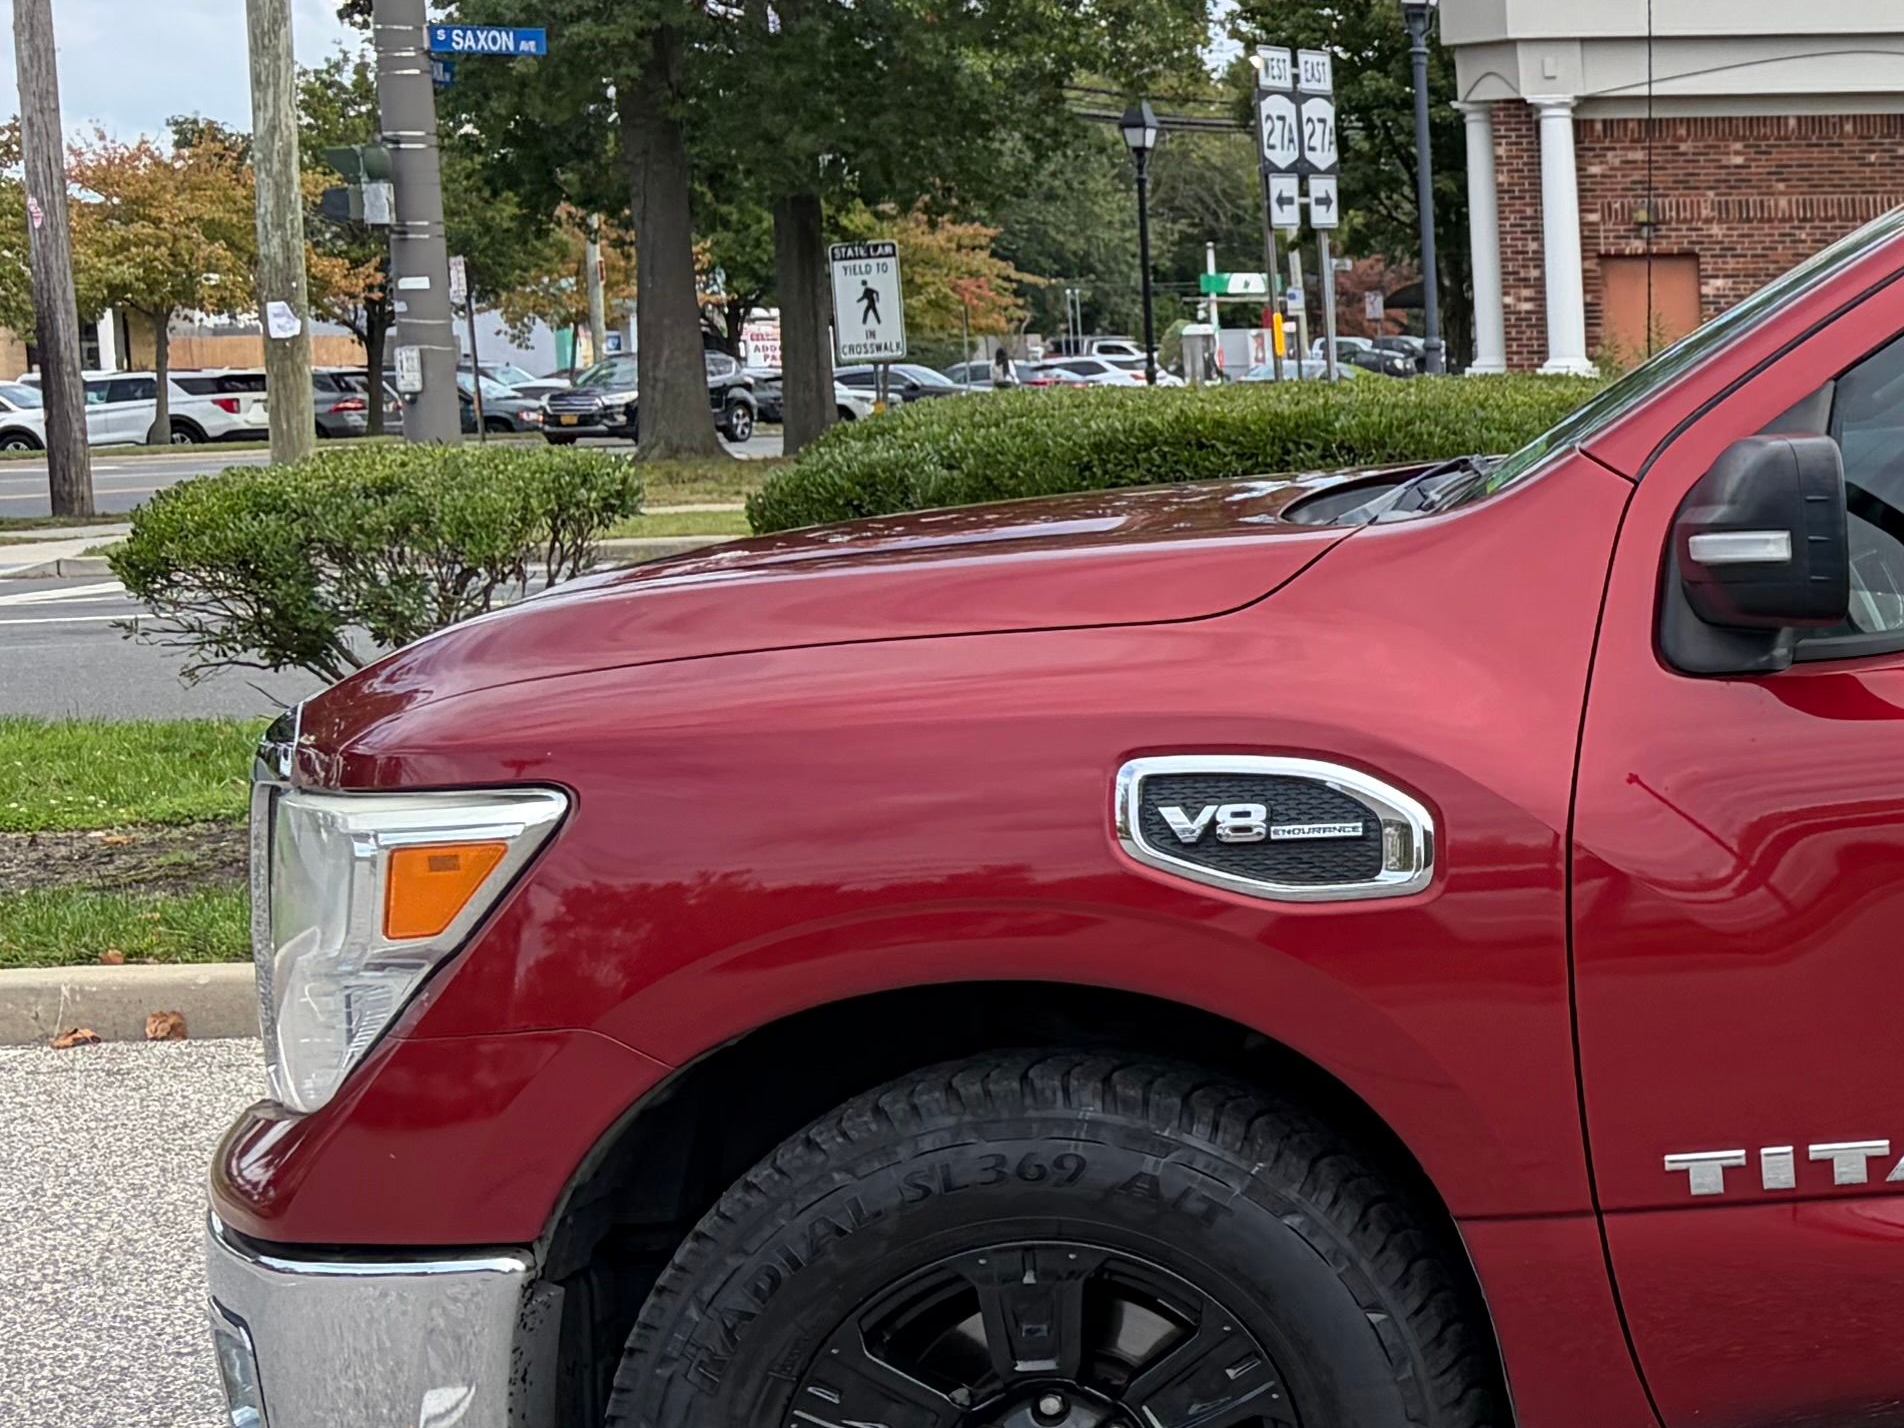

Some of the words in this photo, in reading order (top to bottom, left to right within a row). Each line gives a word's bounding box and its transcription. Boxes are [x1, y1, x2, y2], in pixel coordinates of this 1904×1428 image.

[436, 29, 446, 40] S
[452, 30, 515, 52] SAXON
[1263, 57, 1288, 81] WEST
[1304, 60, 1327, 83] EAST
[1265, 114, 1297, 152] 27A
[834, 245, 868, 260] STATE
[870, 244, 894, 257] LAW
[842, 263, 872, 276] YIELD
[876, 262, 888, 274] TO
[865, 330, 876, 340] IN
[841, 341, 901, 356] CROSSWALK
[1158, 803, 1267, 843] V8
[1271, 824, 1361, 837] ENDURANCE
[683, 1193, 883, 1394] RADIAL
[901, 1152, 1088, 1205] SL369
[1112, 1169, 1234, 1229] A/T
